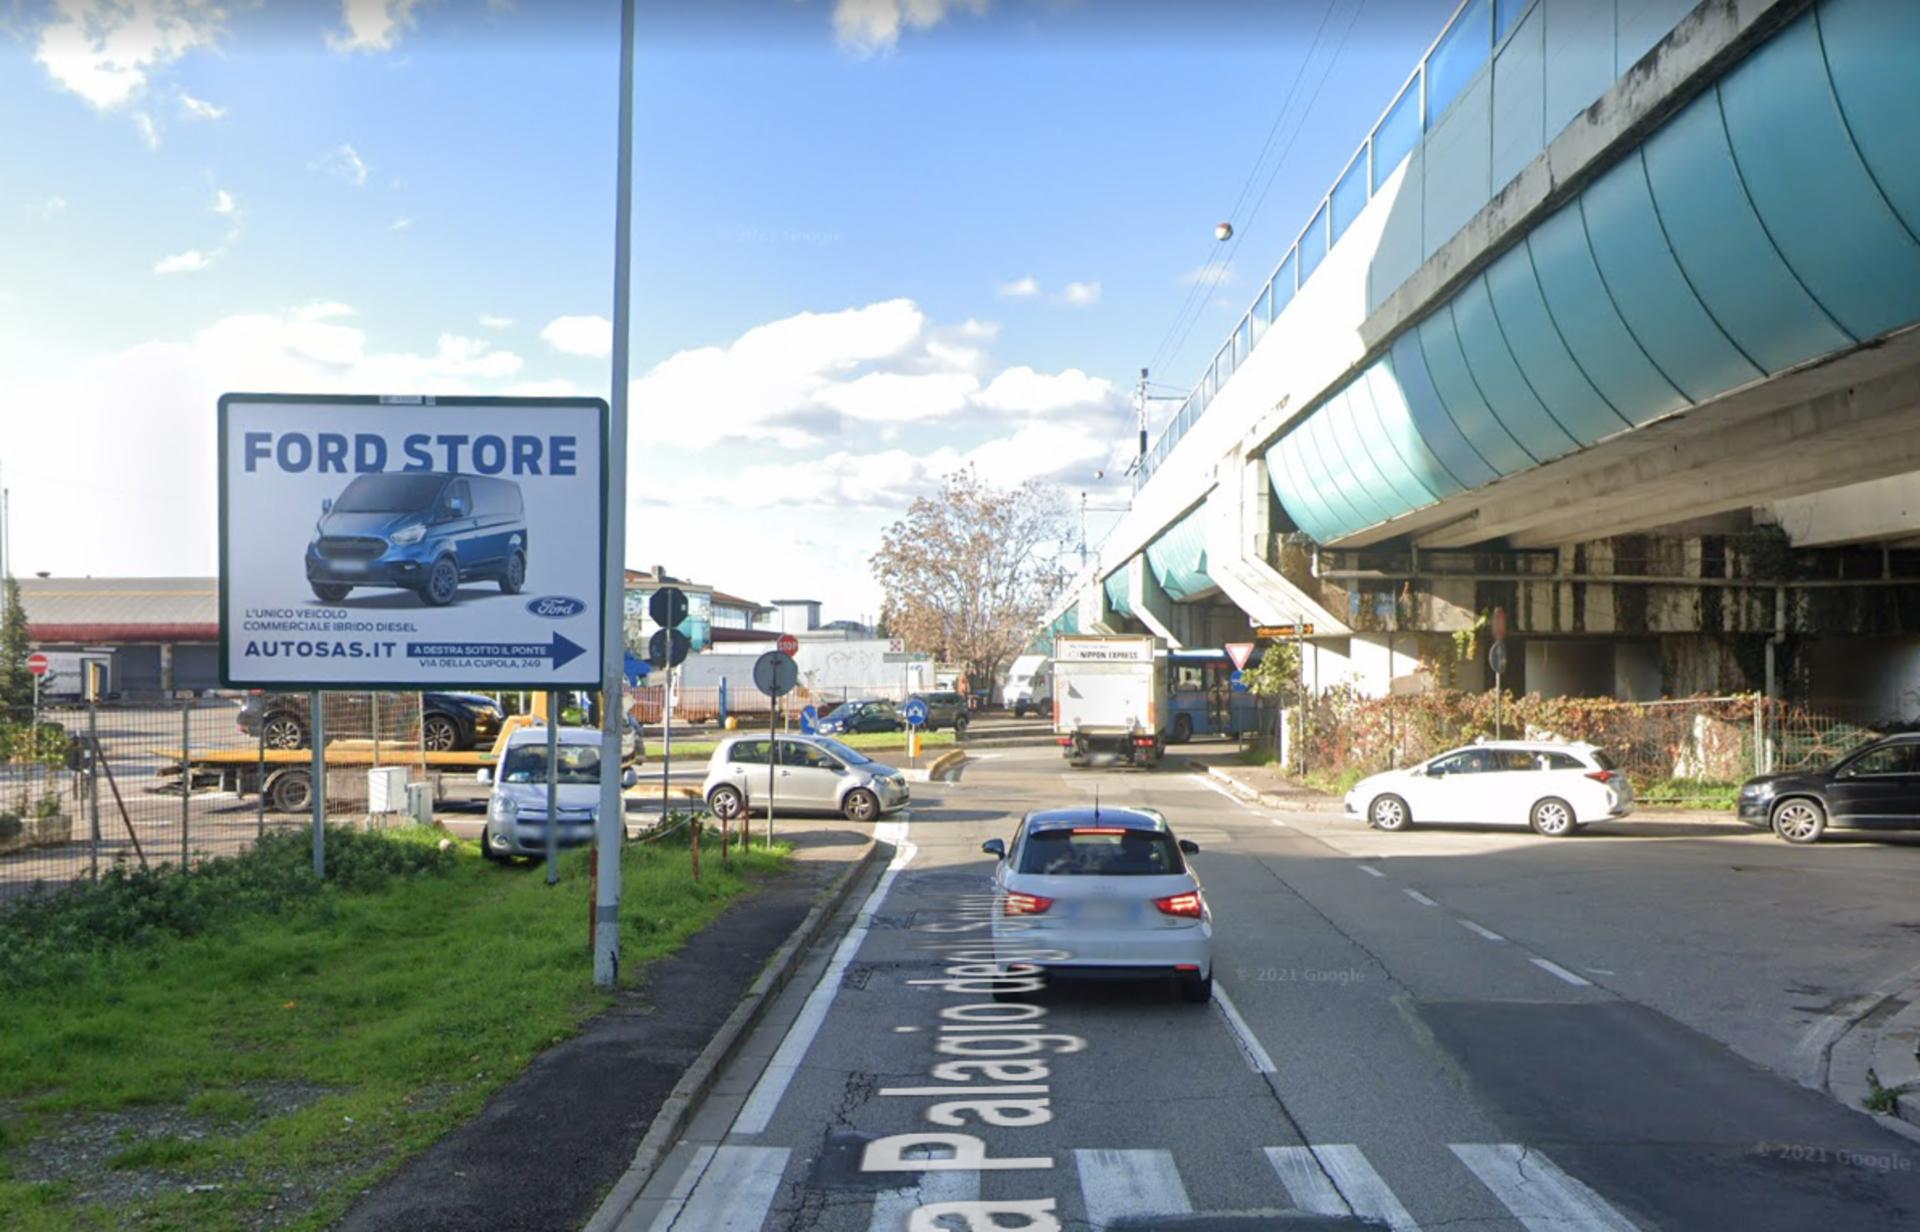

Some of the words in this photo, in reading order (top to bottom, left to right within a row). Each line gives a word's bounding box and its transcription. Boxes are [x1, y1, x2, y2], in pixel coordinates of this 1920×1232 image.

[244, 432, 388, 473] FORD
[402, 433, 577, 476] STORE
[537, 599, 576, 616] Ford
[245, 608, 294, 619] L'UNICO
[296, 609, 348, 620] VEICOLO
[243, 621, 331, 632] COMMERCIALE
[333, 622, 374, 632] IBRIDO
[376, 622, 418, 633] DIESEL
[244, 640, 397, 658] AUTOSAS.IT
[414, 646, 422, 655] A
[423, 646, 463, 655] DESTRA
[464, 646, 499, 655] SOTTO
[501, 647, 511, 655] IL
[511, 646, 547, 655] PONTE
[778, 641, 798, 651] STOP
[1080, 651, 1106, 659] NIPPON
[1108, 651, 1138, 659] EXPRESS
[418, 658, 438, 668] VIA
[439, 658, 473, 668] DELLA
[473, 658, 520, 669] CUPOLA,
